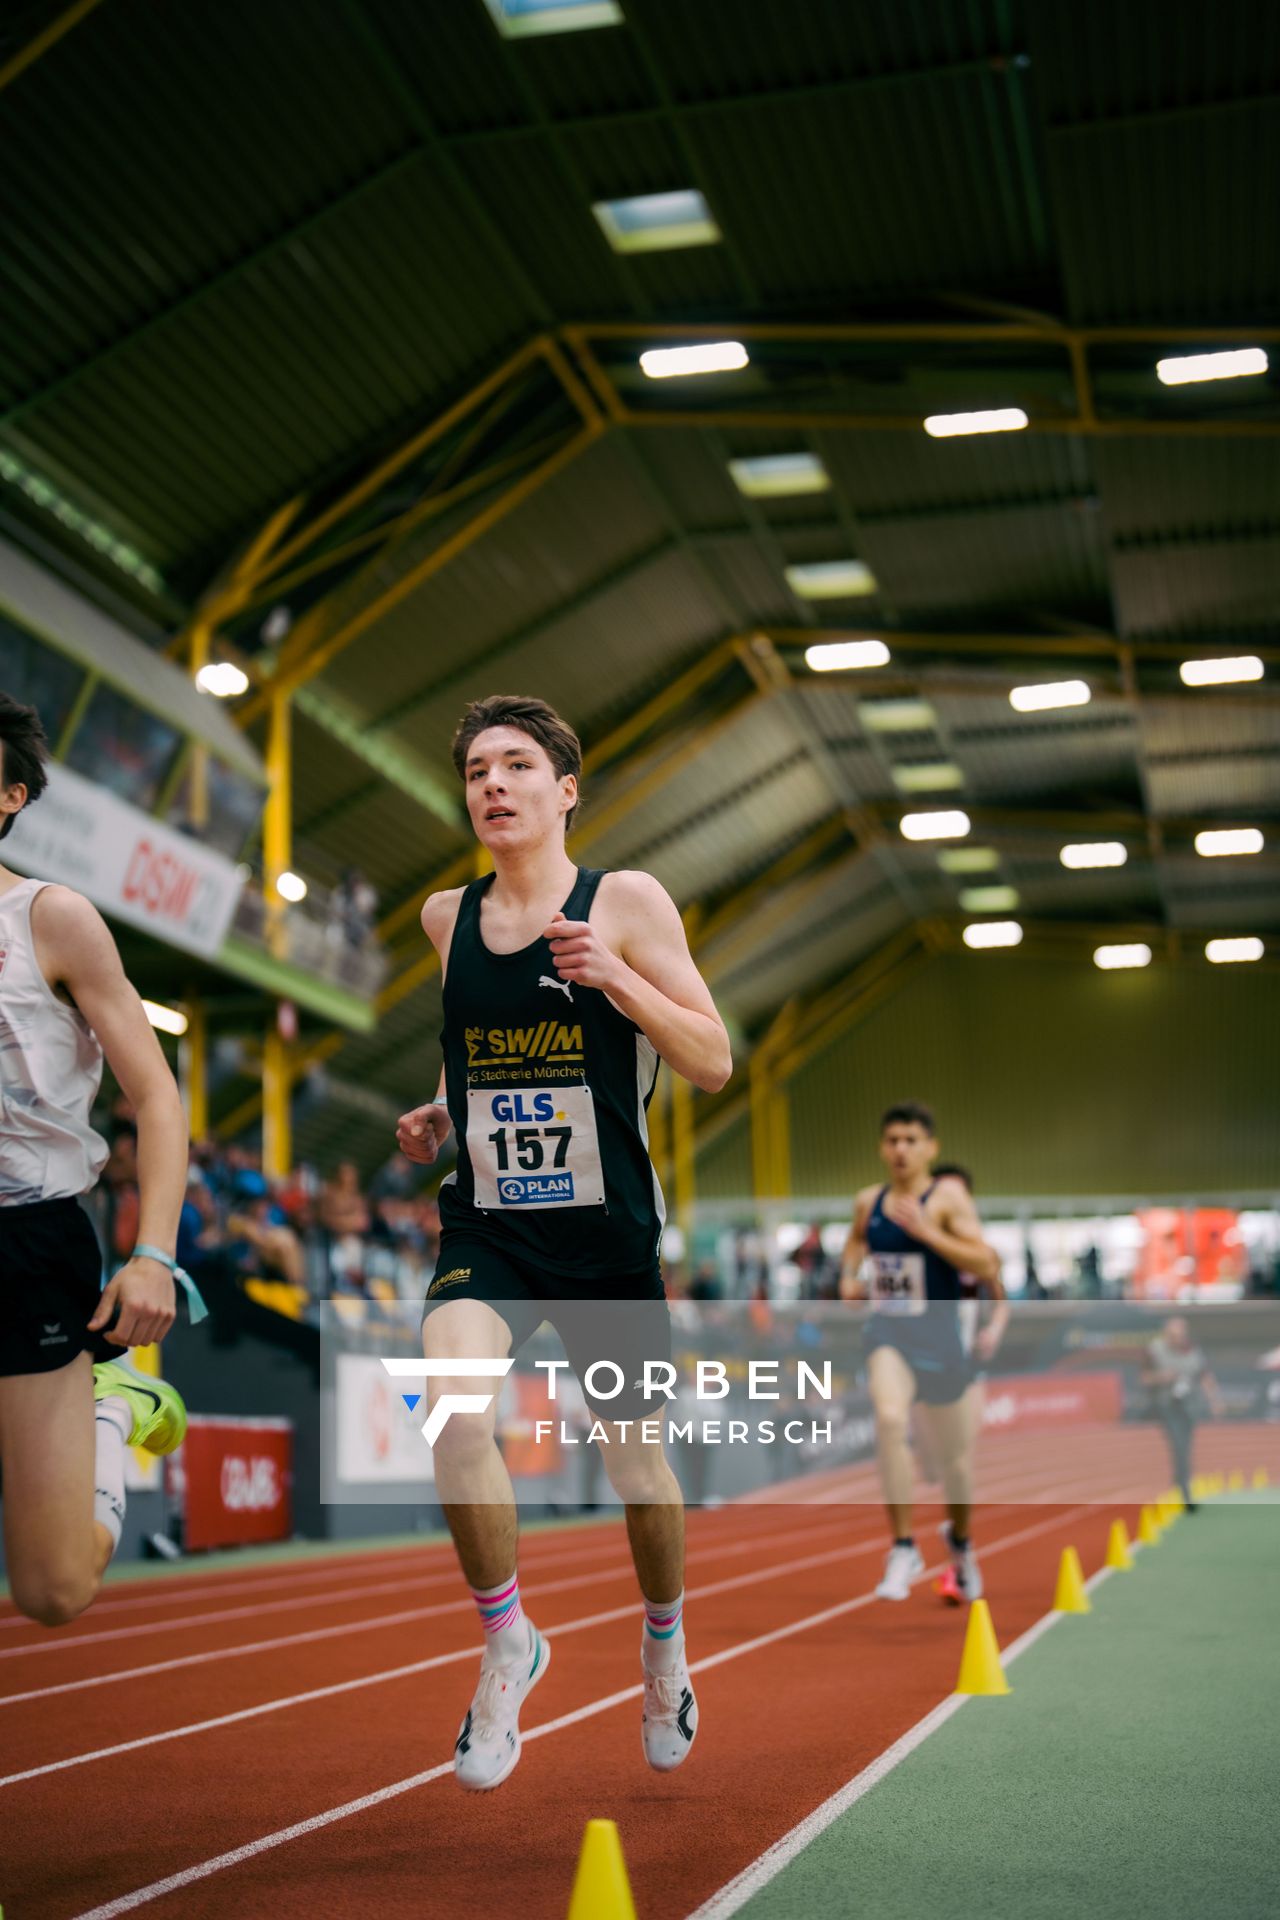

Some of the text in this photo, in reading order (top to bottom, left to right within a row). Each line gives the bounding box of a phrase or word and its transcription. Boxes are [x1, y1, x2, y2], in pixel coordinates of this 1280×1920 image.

[488, 1126, 572, 1170] 157
[527, 1179, 570, 1193] PLAN
[528, 1192, 571, 1200] INTERNATIONAL
